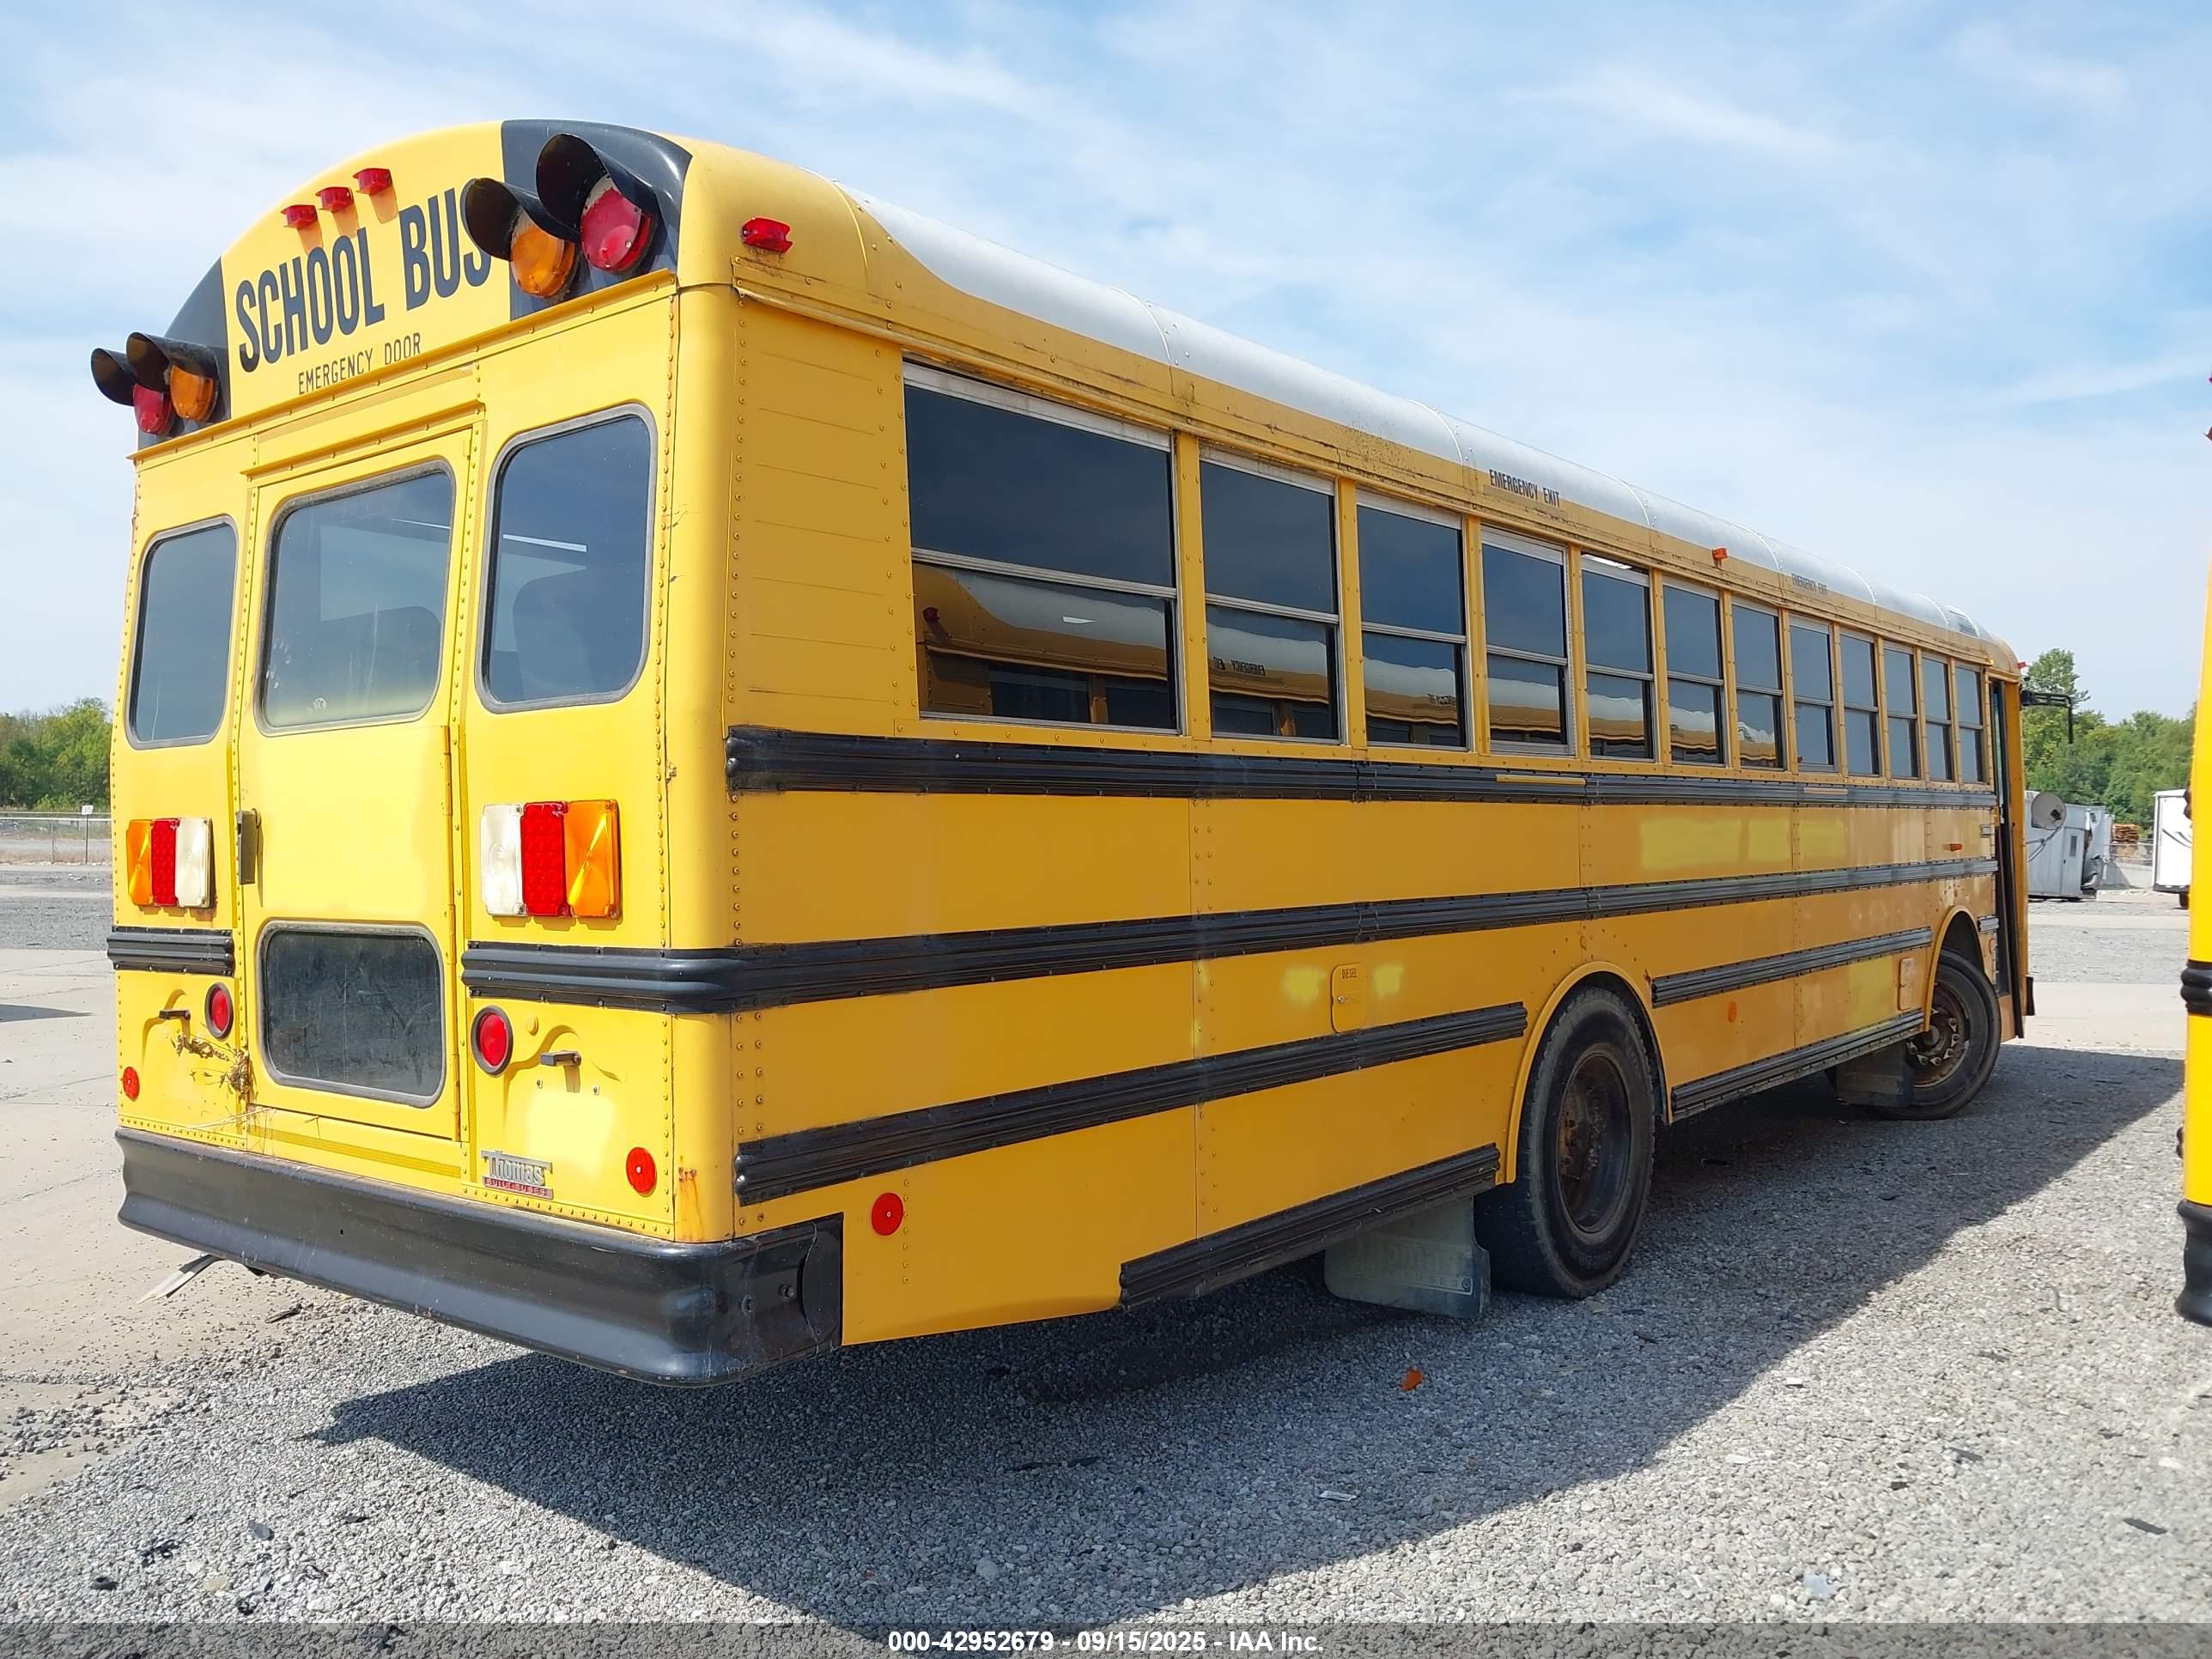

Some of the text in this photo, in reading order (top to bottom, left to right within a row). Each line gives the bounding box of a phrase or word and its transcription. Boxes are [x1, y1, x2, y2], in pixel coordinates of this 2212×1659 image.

[235, 178, 492, 374] SCHOOL BUS
[298, 331, 421, 395] EMERGENCY DOOR
[1488, 468, 1560, 508] EMERGENCY EXIT
[1341, 968, 1358, 979] DIESEL
[481, 1150, 553, 1186] Thomas
